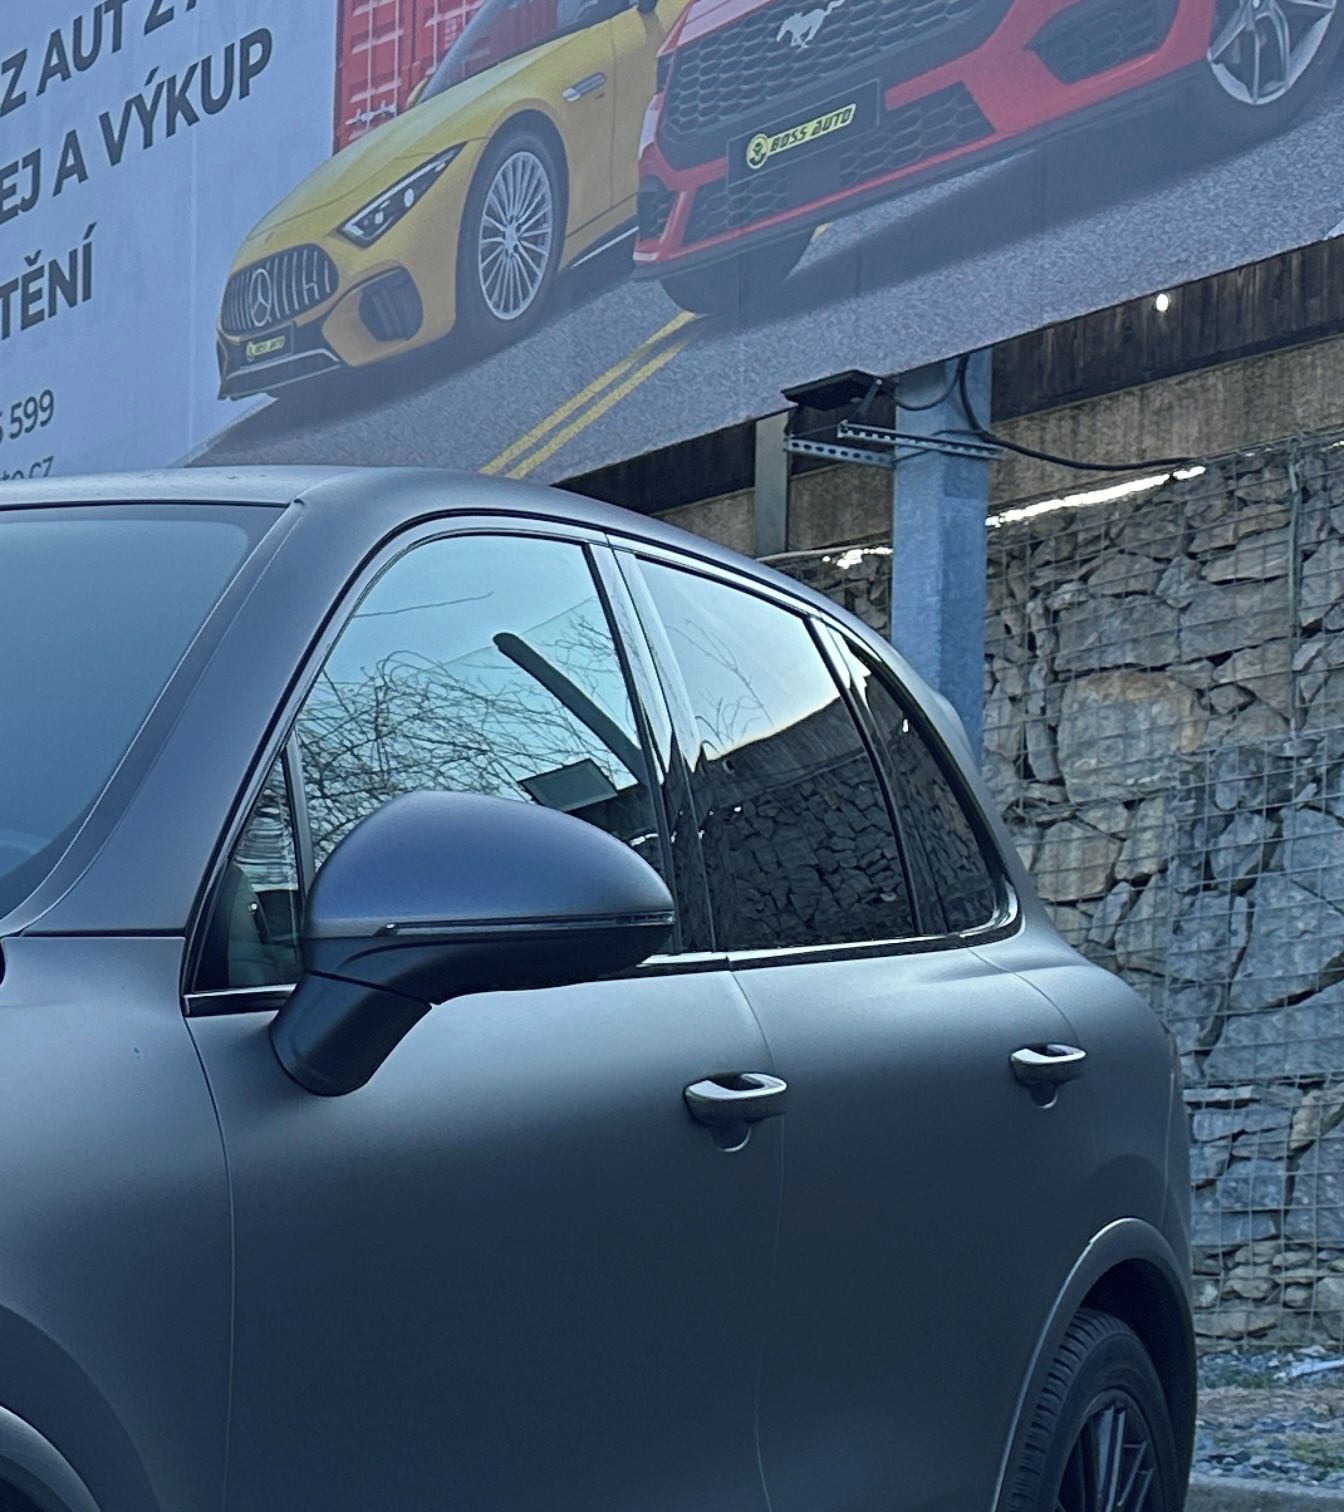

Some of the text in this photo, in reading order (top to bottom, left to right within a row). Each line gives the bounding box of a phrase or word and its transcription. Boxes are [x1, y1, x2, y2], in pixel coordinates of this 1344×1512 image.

[36, 0, 131, 97] AUT
[53, 129, 88, 197] A
[99, 27, 273, 167] VÝKUP
[9, 389, 54, 439] 599
